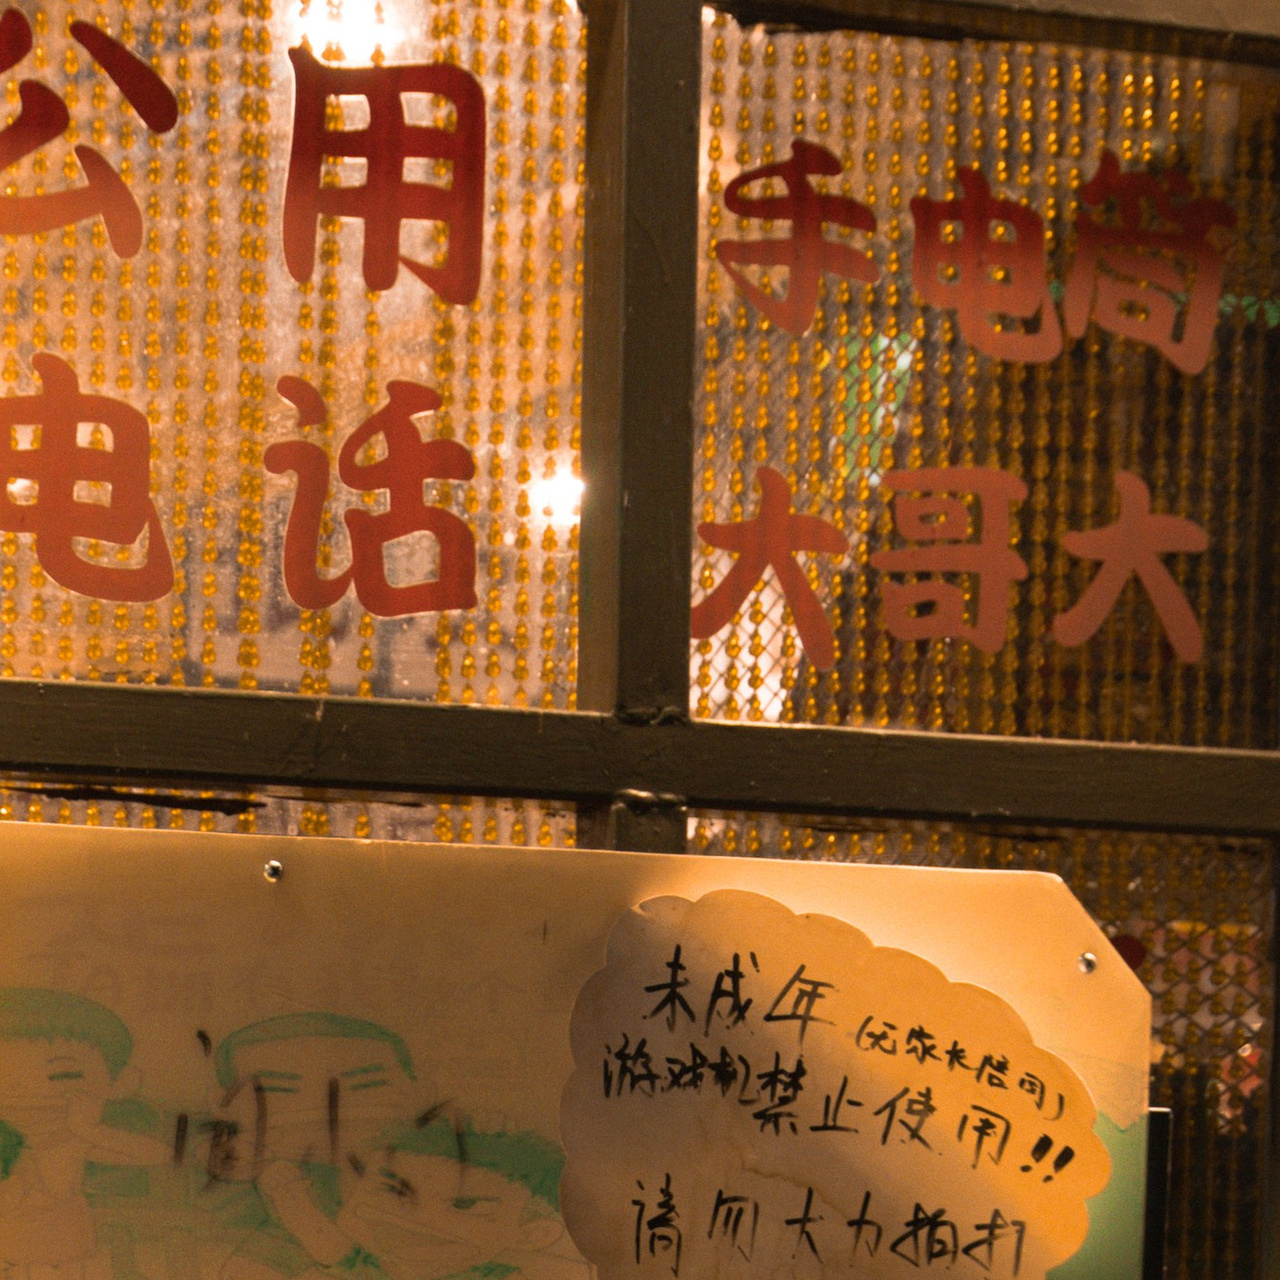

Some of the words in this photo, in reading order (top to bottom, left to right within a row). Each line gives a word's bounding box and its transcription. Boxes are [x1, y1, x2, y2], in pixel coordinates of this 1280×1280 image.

[718, 138, 1240, 375] 手电筒
[690, 466, 1209, 670] 大哥大
[643, 945, 837, 1047] 未成年
[632, 1173, 1027, 1278] 请勿大力拍打
